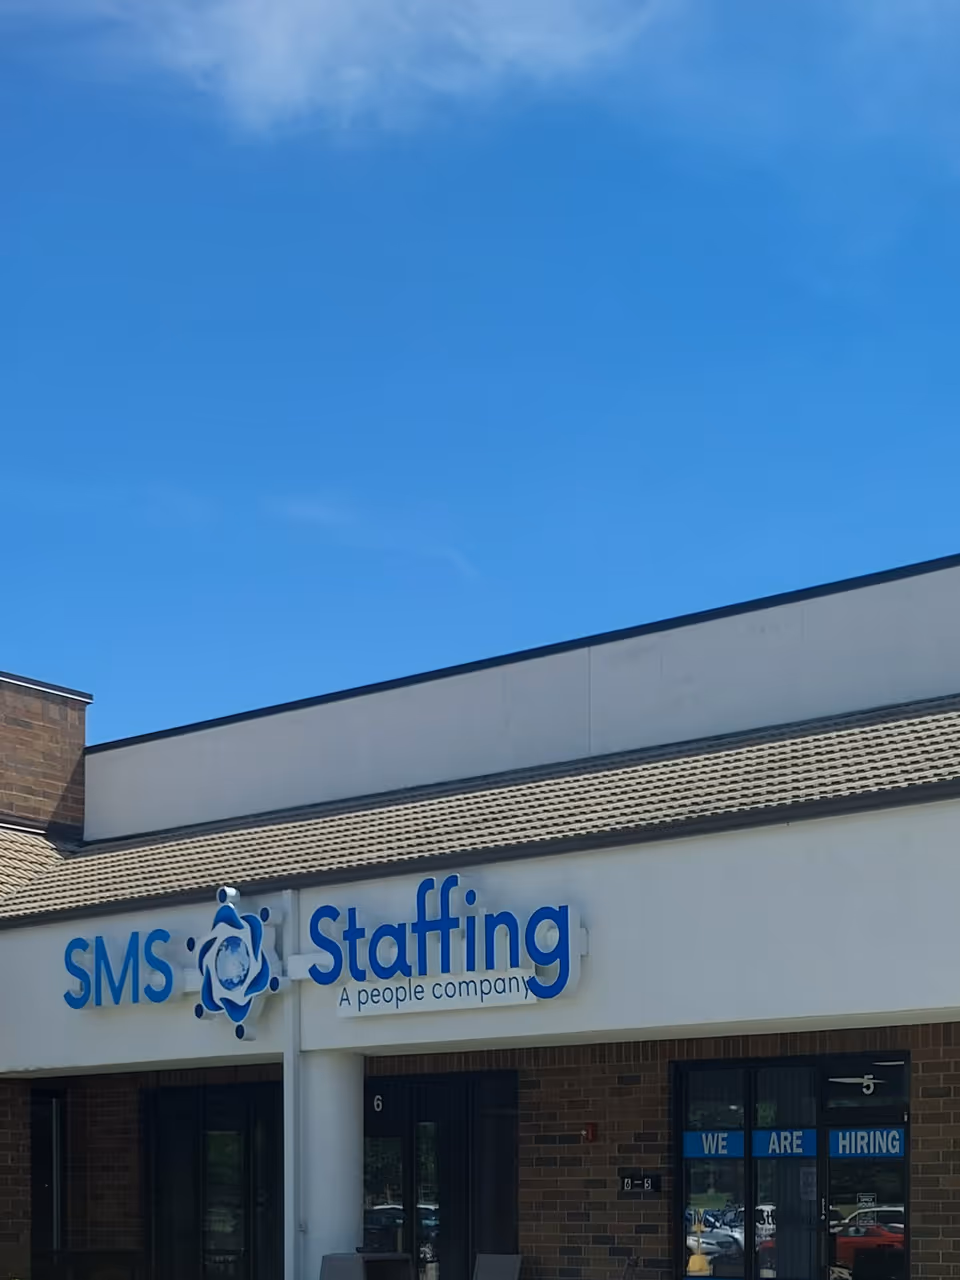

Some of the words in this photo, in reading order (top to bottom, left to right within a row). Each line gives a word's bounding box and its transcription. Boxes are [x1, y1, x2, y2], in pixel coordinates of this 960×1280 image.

[308, 873, 571, 999] Staffing
[63, 927, 174, 1010] SMS
[339, 986, 351, 1007] A
[357, 977, 425, 1012] people
[431, 974, 533, 1003] company
[862, 1074, 875, 1095] 5
[373, 1095, 383, 1112] 6
[702, 1132, 729, 1155] WE
[768, 1131, 803, 1154] ARE
[838, 1130, 900, 1154] HIRING
